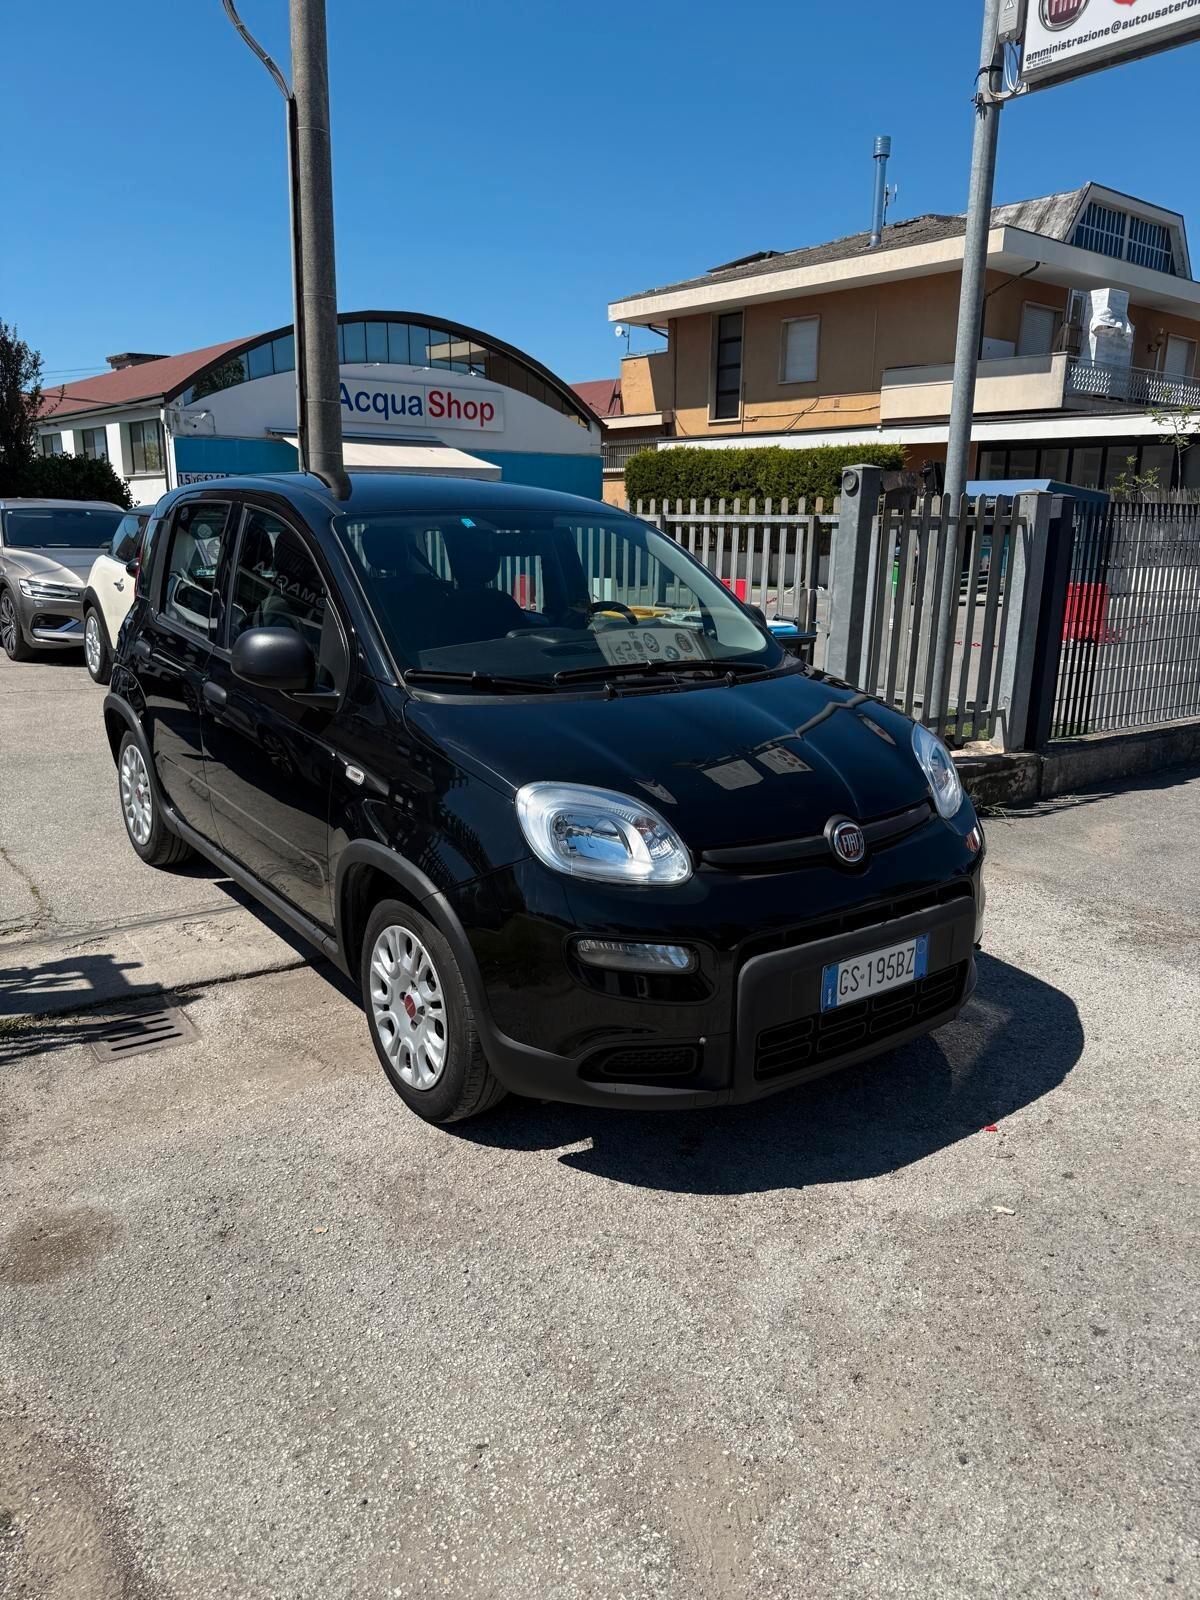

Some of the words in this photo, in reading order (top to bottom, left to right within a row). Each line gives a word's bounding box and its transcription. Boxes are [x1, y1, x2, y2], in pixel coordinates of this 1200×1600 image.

[339, 382, 424, 421] Acqua
[428, 390, 494, 427] Shop
[840, 832, 859, 853] FIAT
[839, 965, 860, 997] GS
[867, 946, 915, 988] 195BZ
